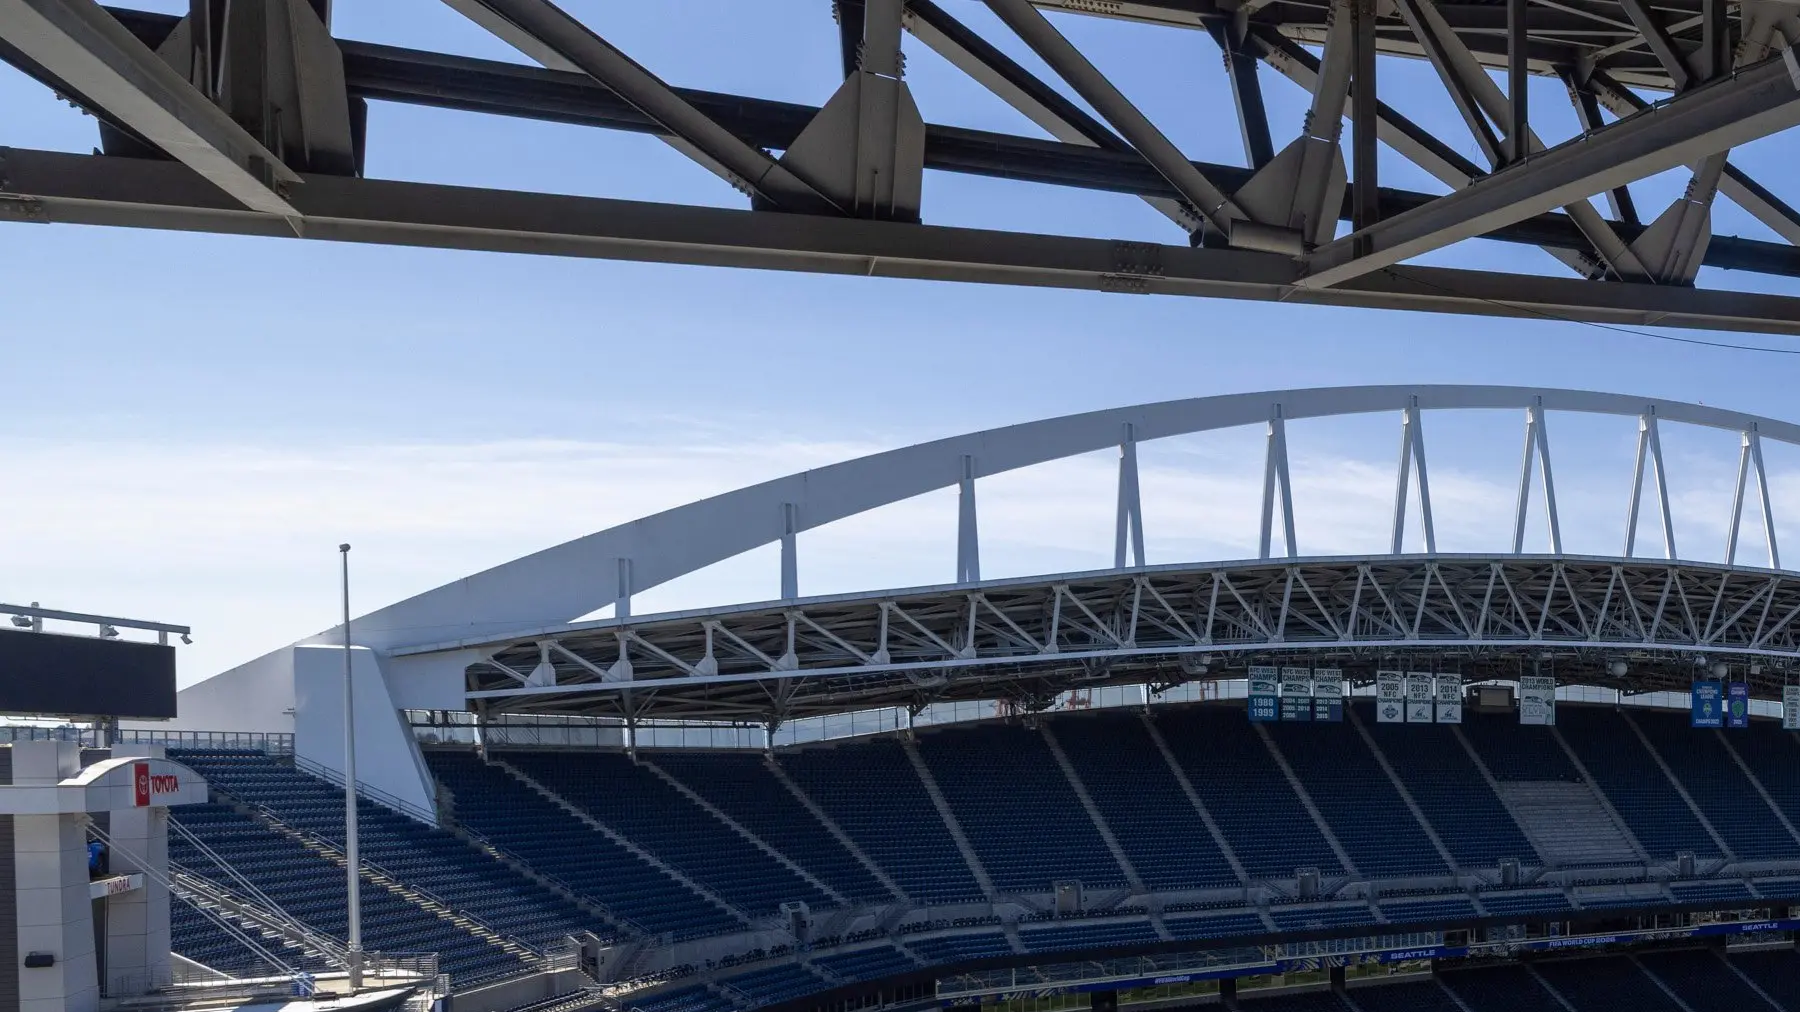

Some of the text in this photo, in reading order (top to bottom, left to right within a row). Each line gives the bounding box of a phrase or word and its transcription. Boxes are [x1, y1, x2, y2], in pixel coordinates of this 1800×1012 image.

[1253, 708, 1274, 717] 1999
[151, 775, 179, 794] TOYOTA
[107, 878, 131, 894] TUNDRA
[1742, 922, 1778, 931] SEATTLE
[1390, 949, 1436, 960] SEATTLE
